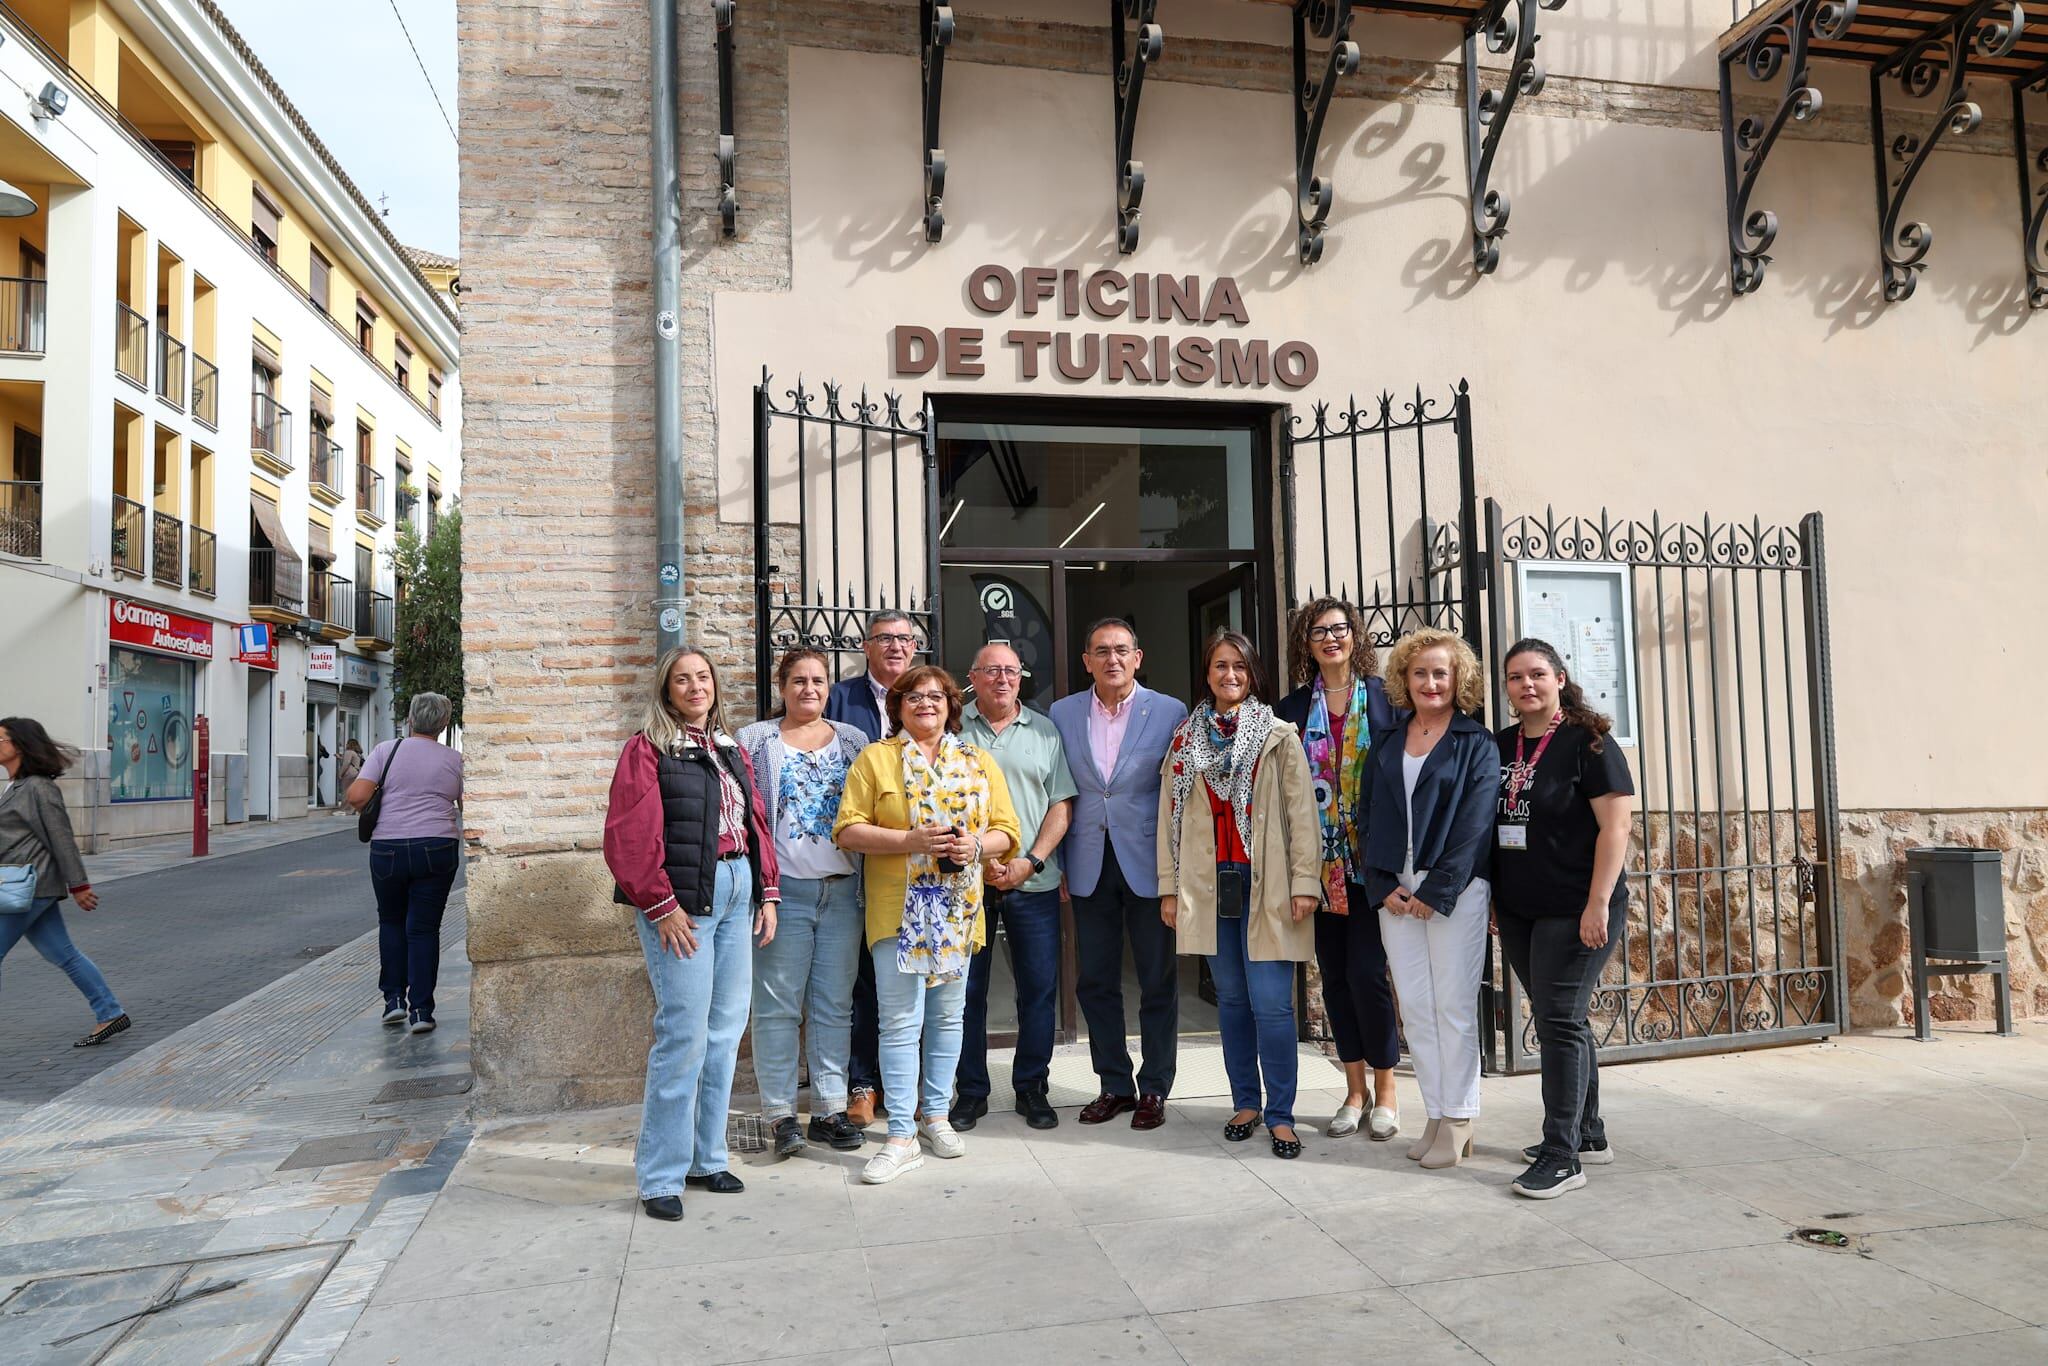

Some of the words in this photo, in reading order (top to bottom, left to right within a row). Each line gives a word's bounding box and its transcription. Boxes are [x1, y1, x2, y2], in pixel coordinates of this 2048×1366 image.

[967, 264, 1250, 325] OFICINA
[895, 325, 986, 377] DE
[1007, 330, 1319, 388] TURISMO
[311, 652, 332, 661] latin
